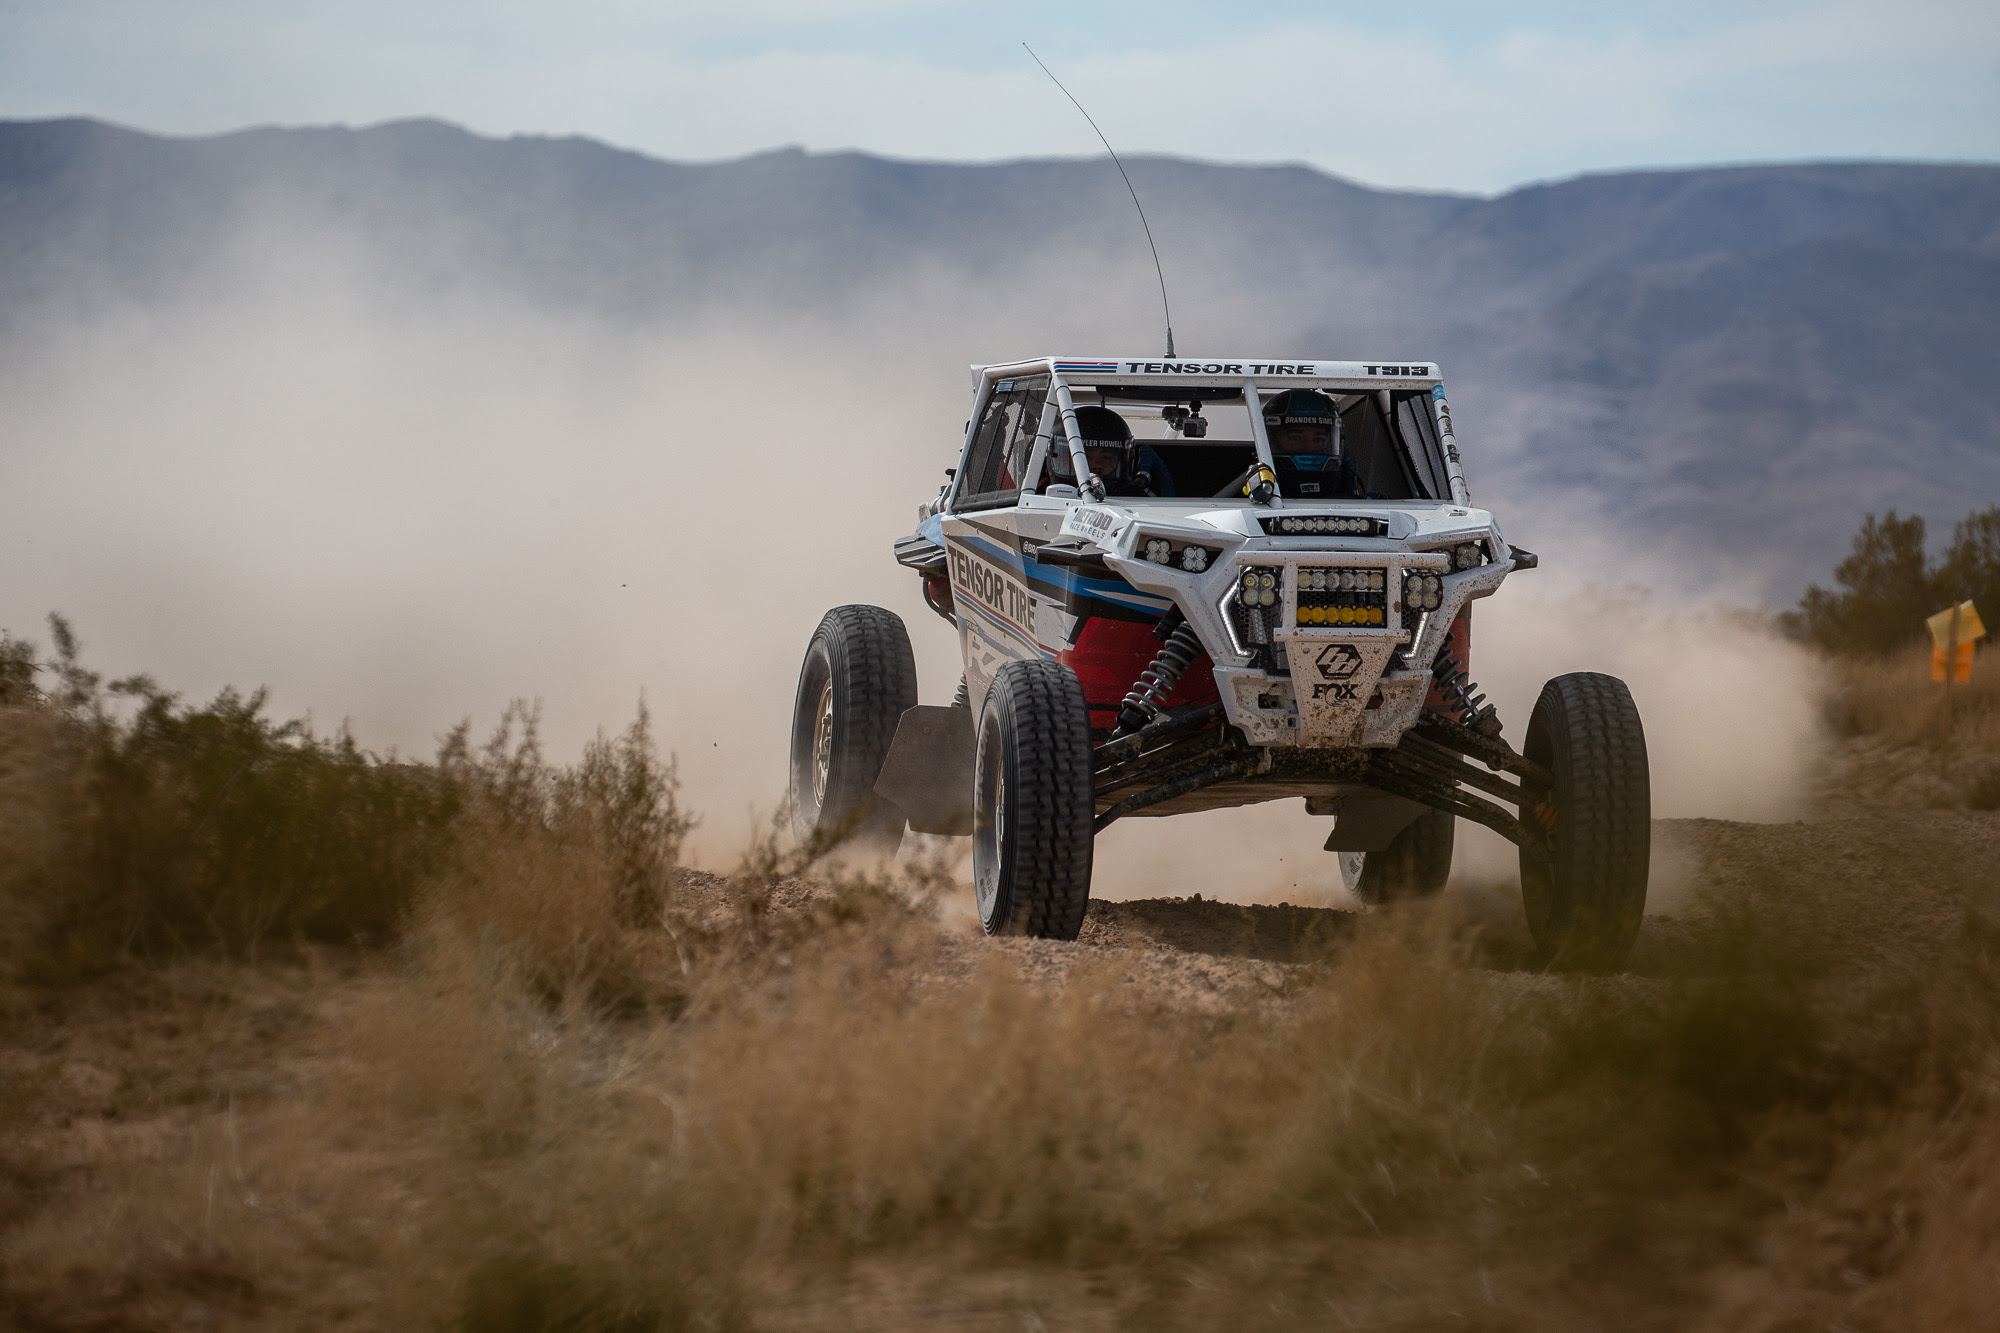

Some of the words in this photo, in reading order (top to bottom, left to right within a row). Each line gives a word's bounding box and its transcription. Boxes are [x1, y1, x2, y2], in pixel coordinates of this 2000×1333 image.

[1125, 362, 1243, 375] TENSOR
[1284, 416, 1317, 424] BRANDEN
[1318, 417, 1333, 425] SIMS
[1099, 440, 1123, 448] HOWELL
[1080, 525, 1106, 540] WHEELS
[946, 543, 1005, 612] TENSOR
[1006, 580, 1038, 634] TIRE
[1311, 683, 1359, 700] FOX
